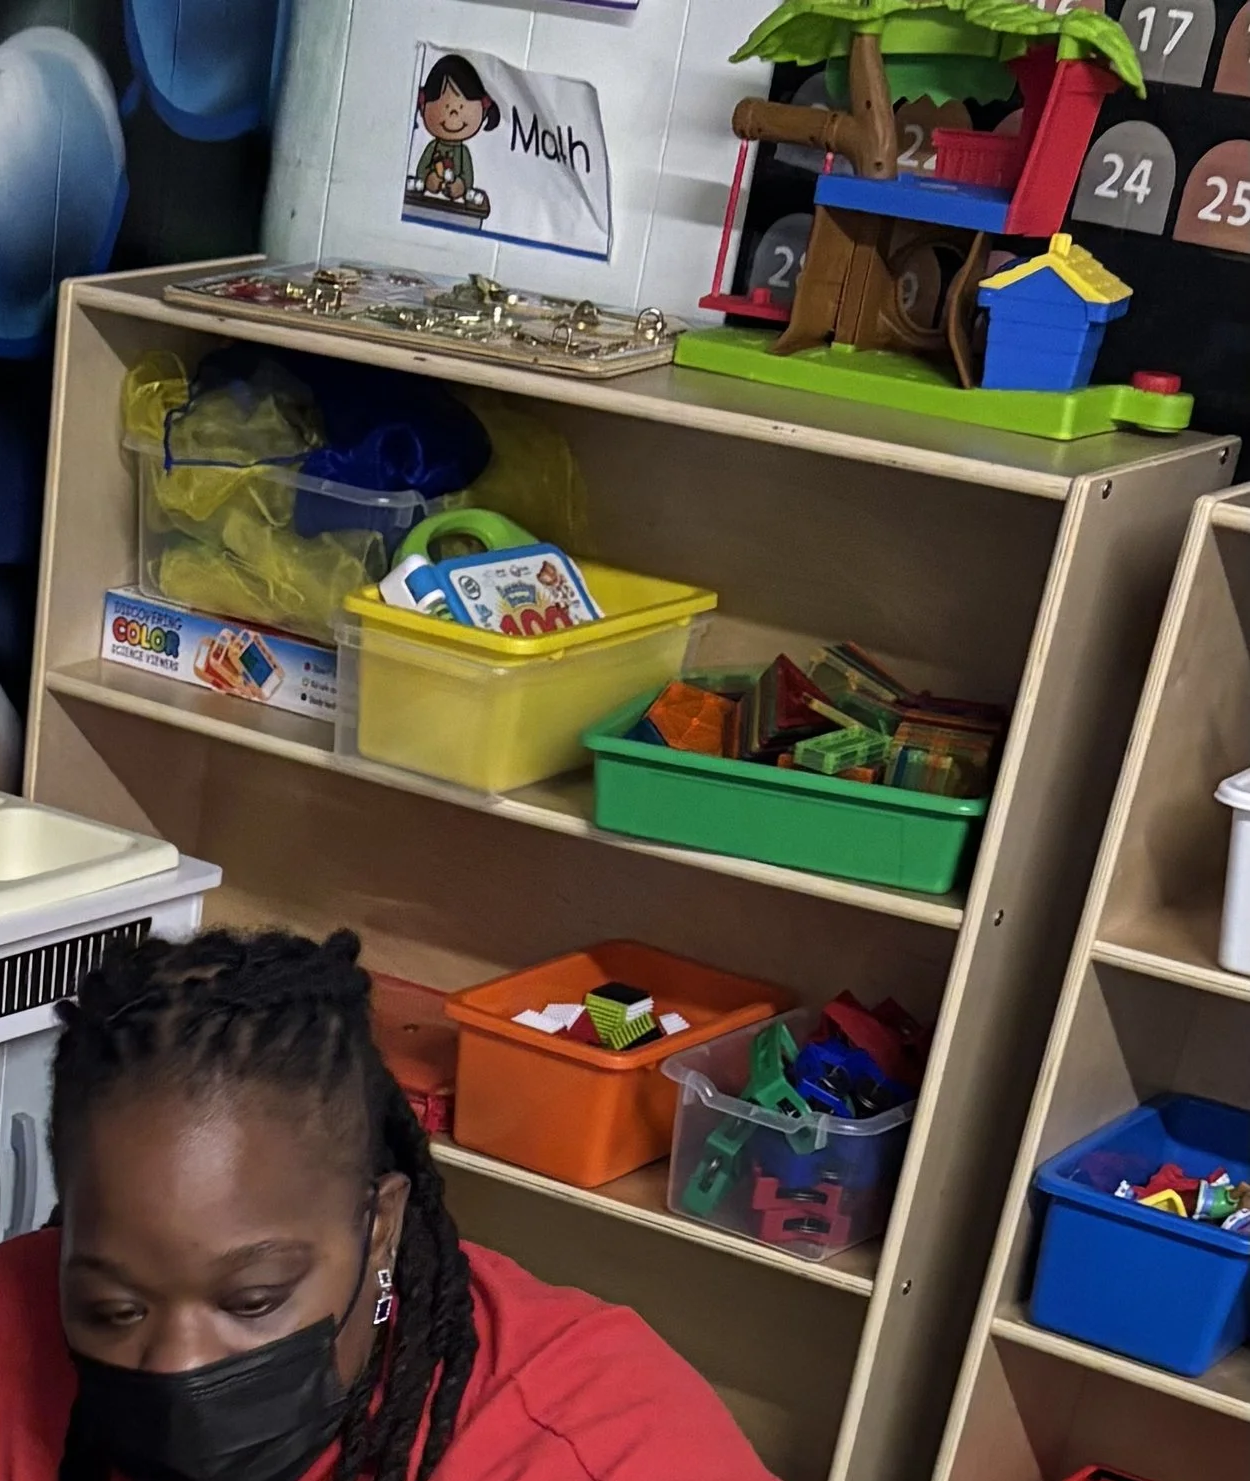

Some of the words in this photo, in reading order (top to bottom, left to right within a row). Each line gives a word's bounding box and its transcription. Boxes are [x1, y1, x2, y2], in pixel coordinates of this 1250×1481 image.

[1137, 6, 1194, 56] 17
[897, 124, 937, 170] 2
[1094, 152, 1153, 205] 24
[768, 246, 806, 288] 2
[111, 615, 181, 659] COLOR
[113, 600, 183, 632] DISCOVERING
